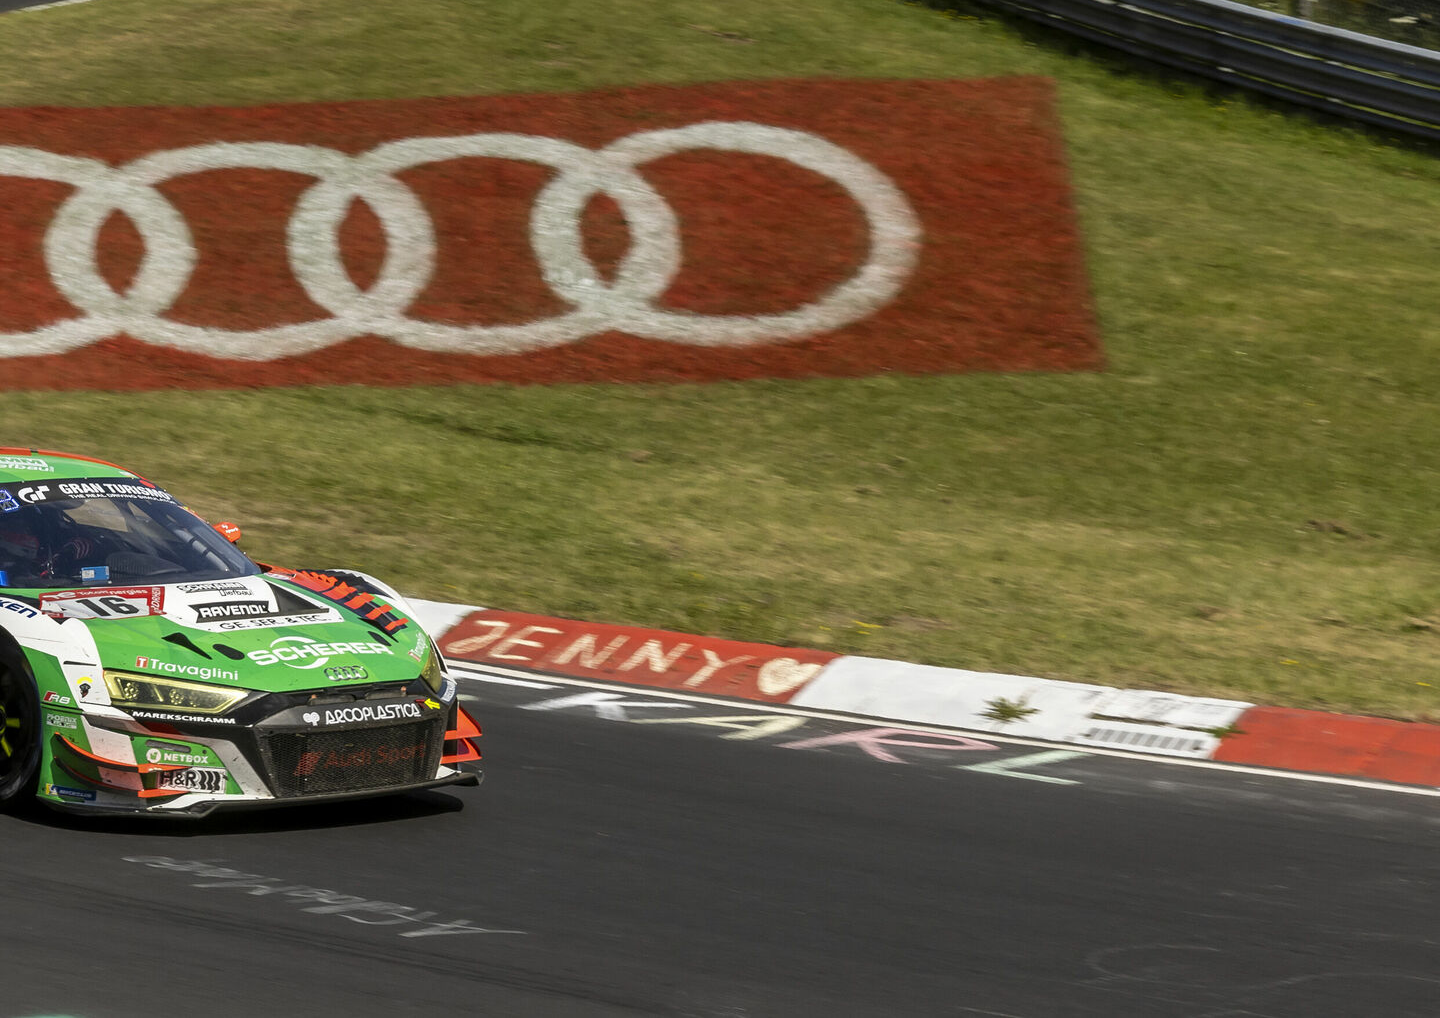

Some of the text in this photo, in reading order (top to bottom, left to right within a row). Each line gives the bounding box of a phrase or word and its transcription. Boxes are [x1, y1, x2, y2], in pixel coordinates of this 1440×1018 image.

[58, 483, 171, 501] GRAN TURISMO
[176, 581, 248, 594] SCHRAMM
[76, 597, 141, 617] 16
[199, 603, 267, 619] RAVENOL
[287, 616, 298, 624] &
[247, 641, 395, 667] SCHERER
[445, 619, 757, 688] JENNY
[150, 659, 239, 681] Travaglini
[325, 703, 422, 725] ARCOPLASTICA
[163, 753, 209, 764] NETBOX
[160, 769, 197, 787] H&R
